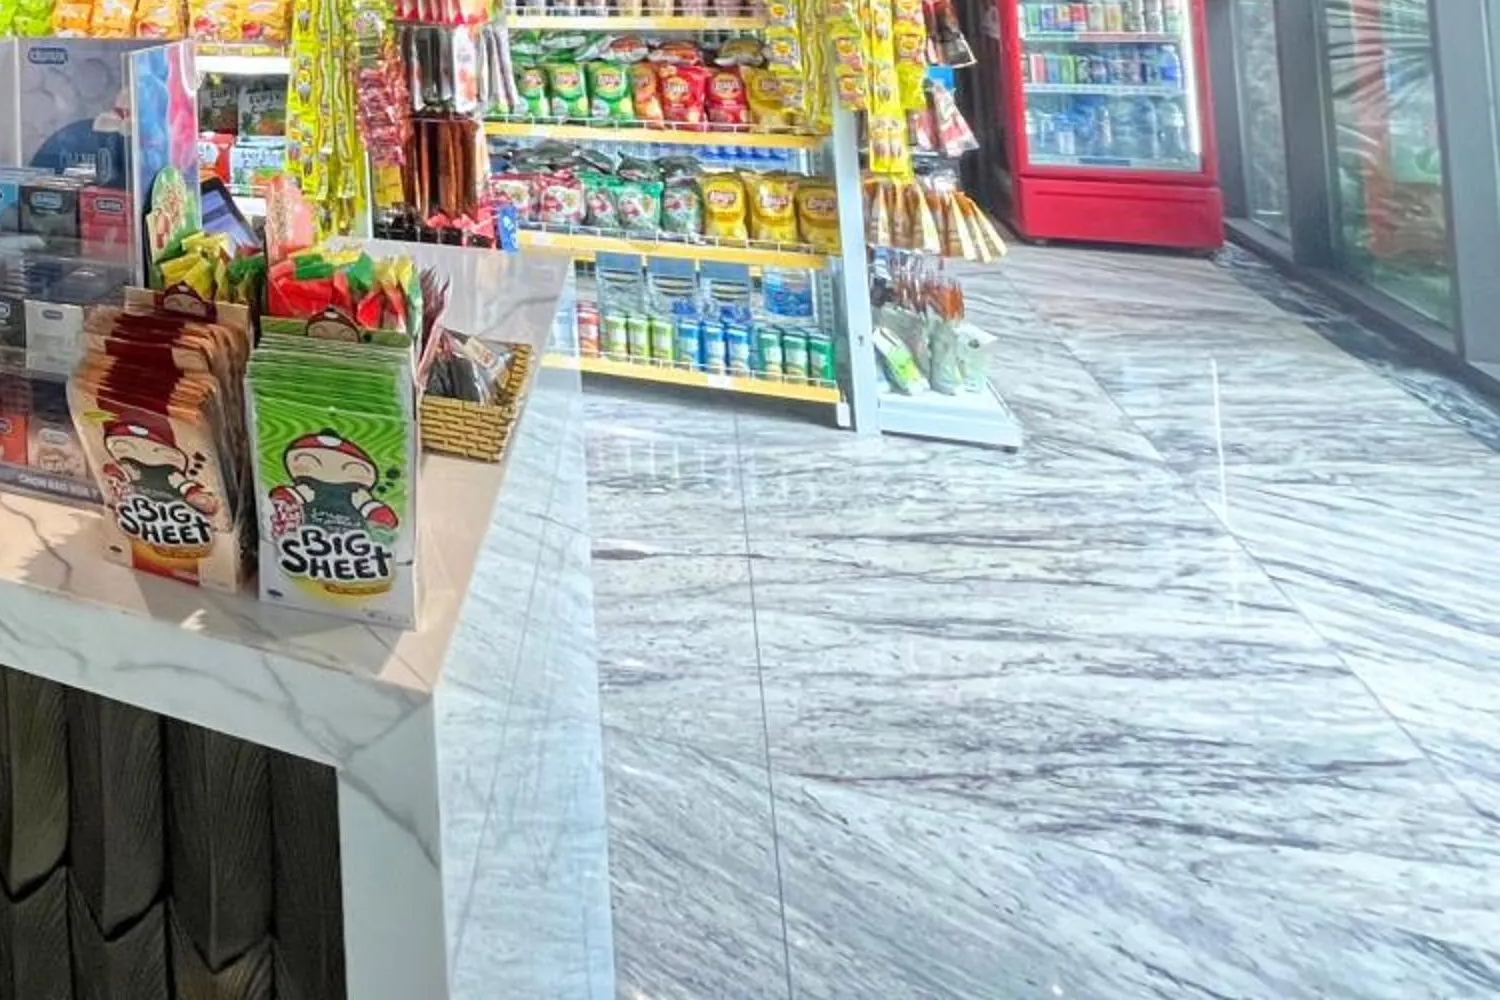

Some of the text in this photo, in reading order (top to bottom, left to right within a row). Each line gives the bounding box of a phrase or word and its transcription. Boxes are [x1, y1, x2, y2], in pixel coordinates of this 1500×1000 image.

[118, 504, 211, 544] SHEET
[131, 497, 191, 523] BIG
[281, 538, 393, 580] SHEET
[301, 528, 371, 557] BIG
